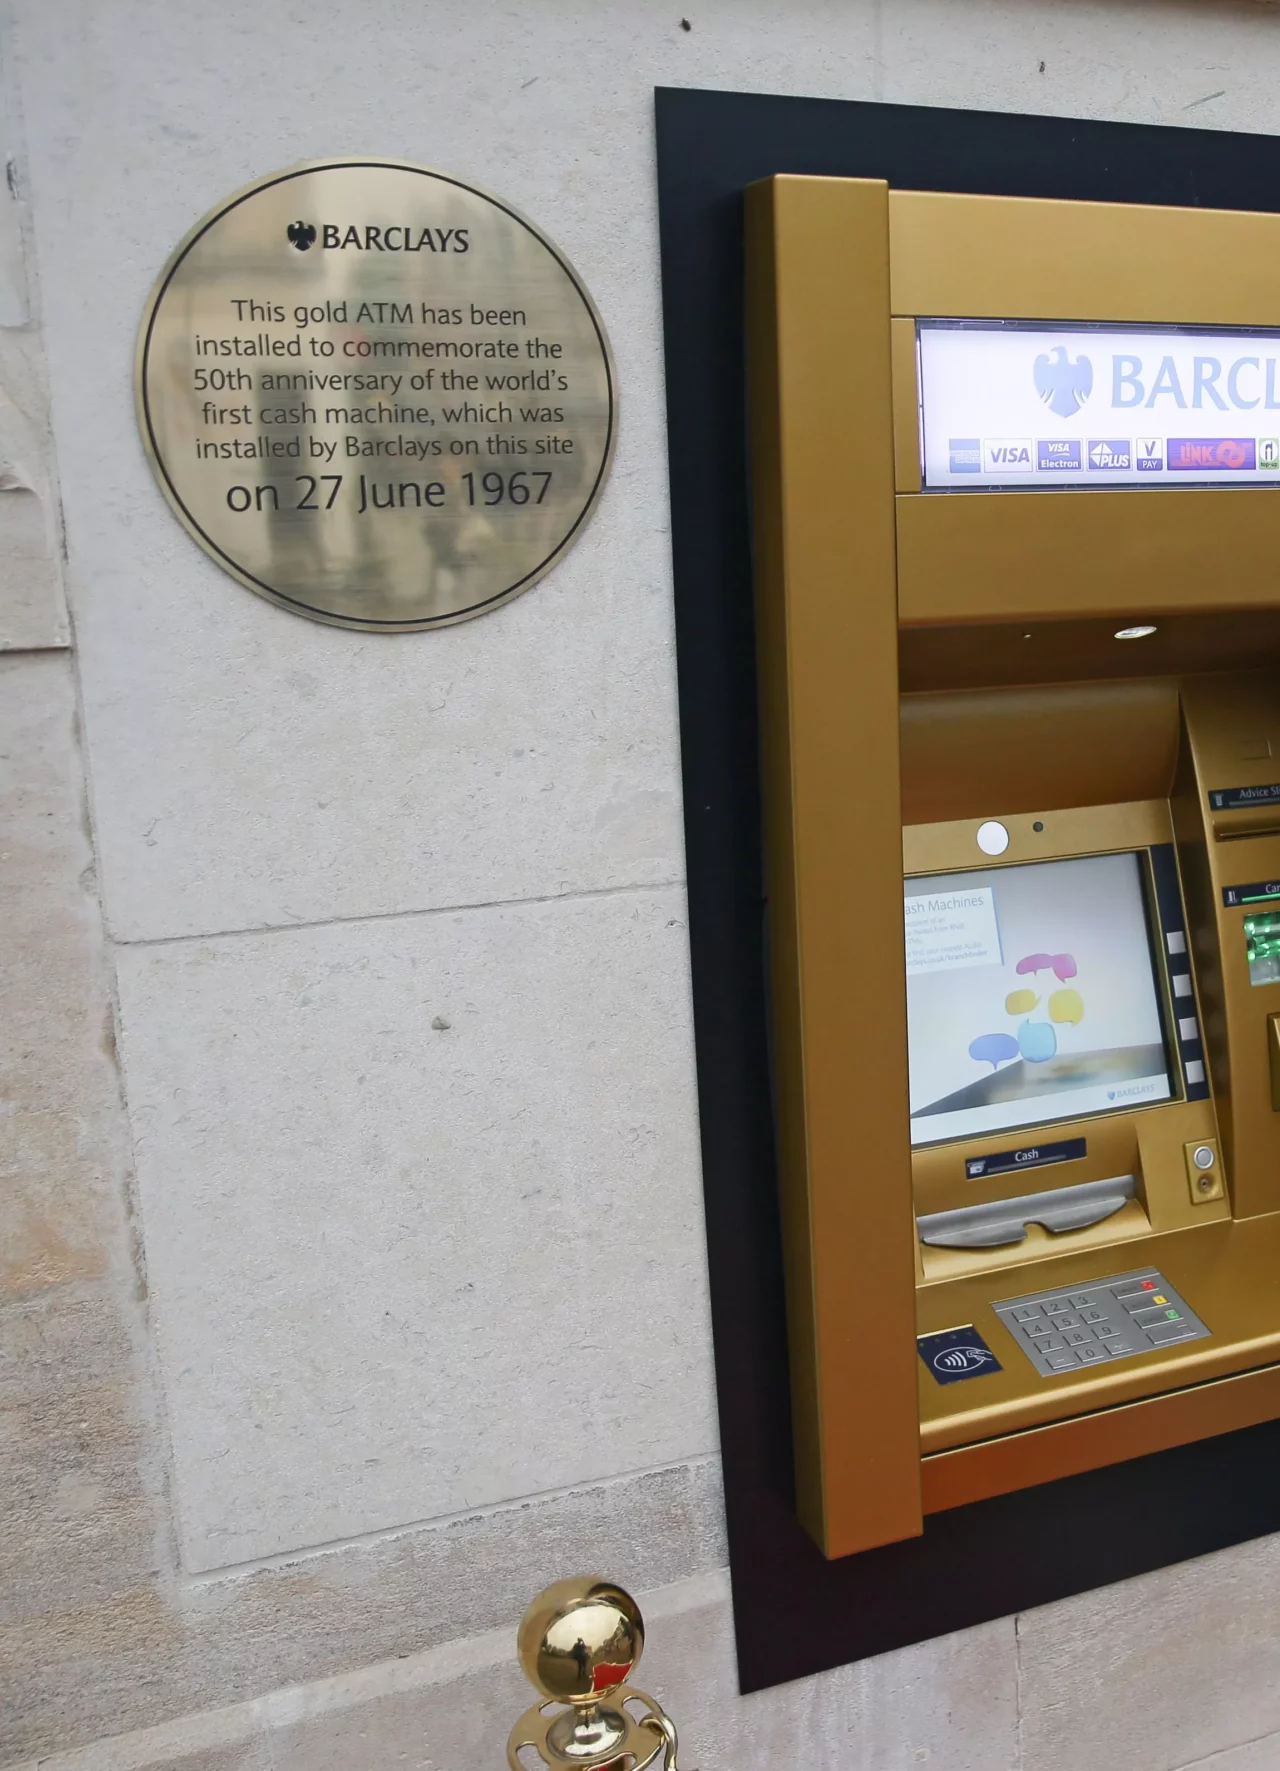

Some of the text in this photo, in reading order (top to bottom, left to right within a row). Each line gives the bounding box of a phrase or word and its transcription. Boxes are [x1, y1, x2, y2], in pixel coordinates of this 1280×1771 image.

[323, 224, 470, 253] BARCLAYS
[231, 299, 526, 328] This gold ATM has been
[195, 334, 563, 359] installed to commemorate the
[193, 368, 569, 395] 50th anniversary of the world's
[202, 402, 565, 427] first cash machine, which was
[195, 435, 574, 462] installed by Barclays on this site
[990, 447, 1030, 463] VISA
[1048, 443, 1070, 453] VISA
[1145, 440, 1157, 457] V
[1041, 459, 1079, 468] Electron
[1100, 453, 1130, 468] PLUS
[1142, 460, 1158, 469] PAY
[226, 471, 553, 514] on 27 June 1967
[1239, 788, 1269, 799] Advice
[905, 895, 984, 915] ash Machines
[1116, 1083, 1156, 1098] BARCLAYS
[1014, 1149, 1039, 1162] Cash
[1050, 1303, 1061, 1311] 2
[1078, 1296, 1088, 1305] 3
[1033, 1311, 1100, 1333] 4 5 6
[1073, 1333, 1083, 1342] 8
[1102, 1326, 1112, 1335] 9
[1085, 1349, 1095, 1358] 0
